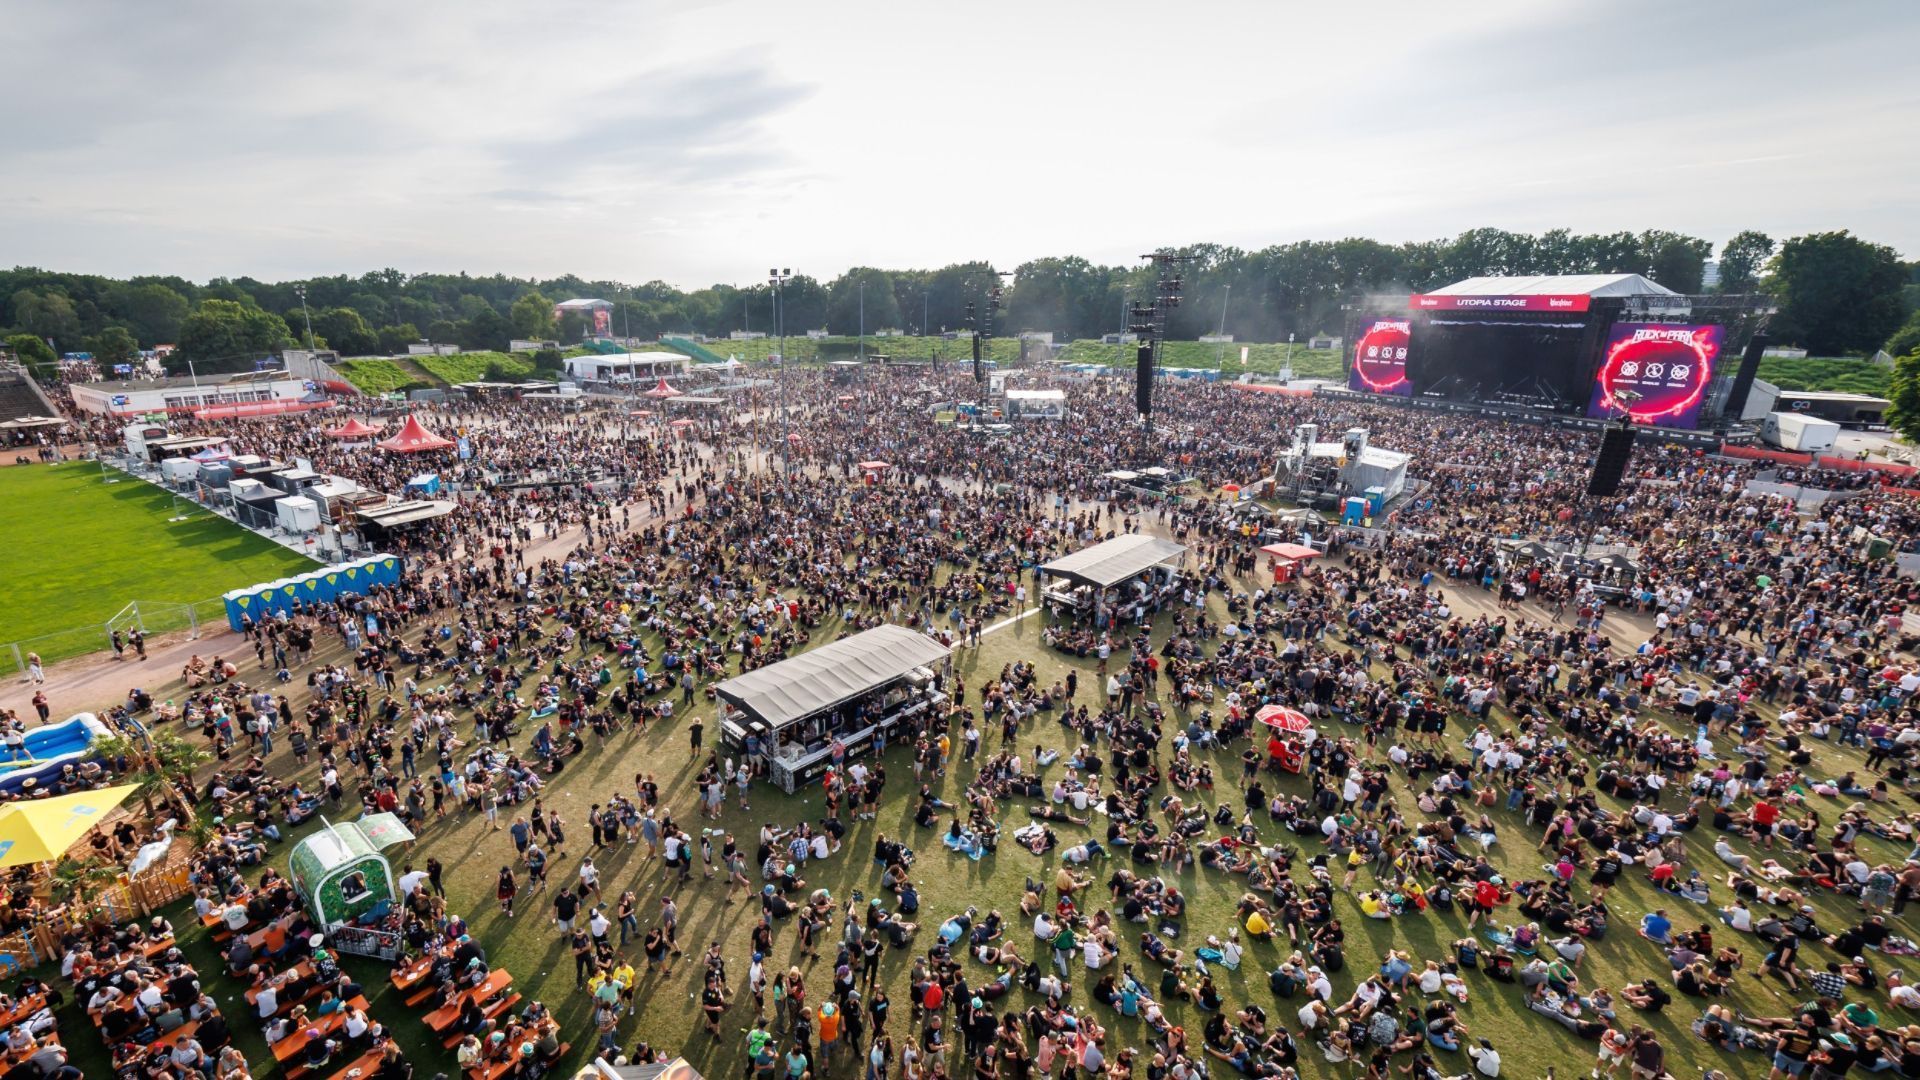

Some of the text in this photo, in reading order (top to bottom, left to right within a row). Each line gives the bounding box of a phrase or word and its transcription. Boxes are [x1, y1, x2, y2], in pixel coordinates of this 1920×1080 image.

[1493, 299, 1527, 307] STAGE
[1632, 329, 1660, 344] ROCK
[1667, 329, 1696, 347] PARK
